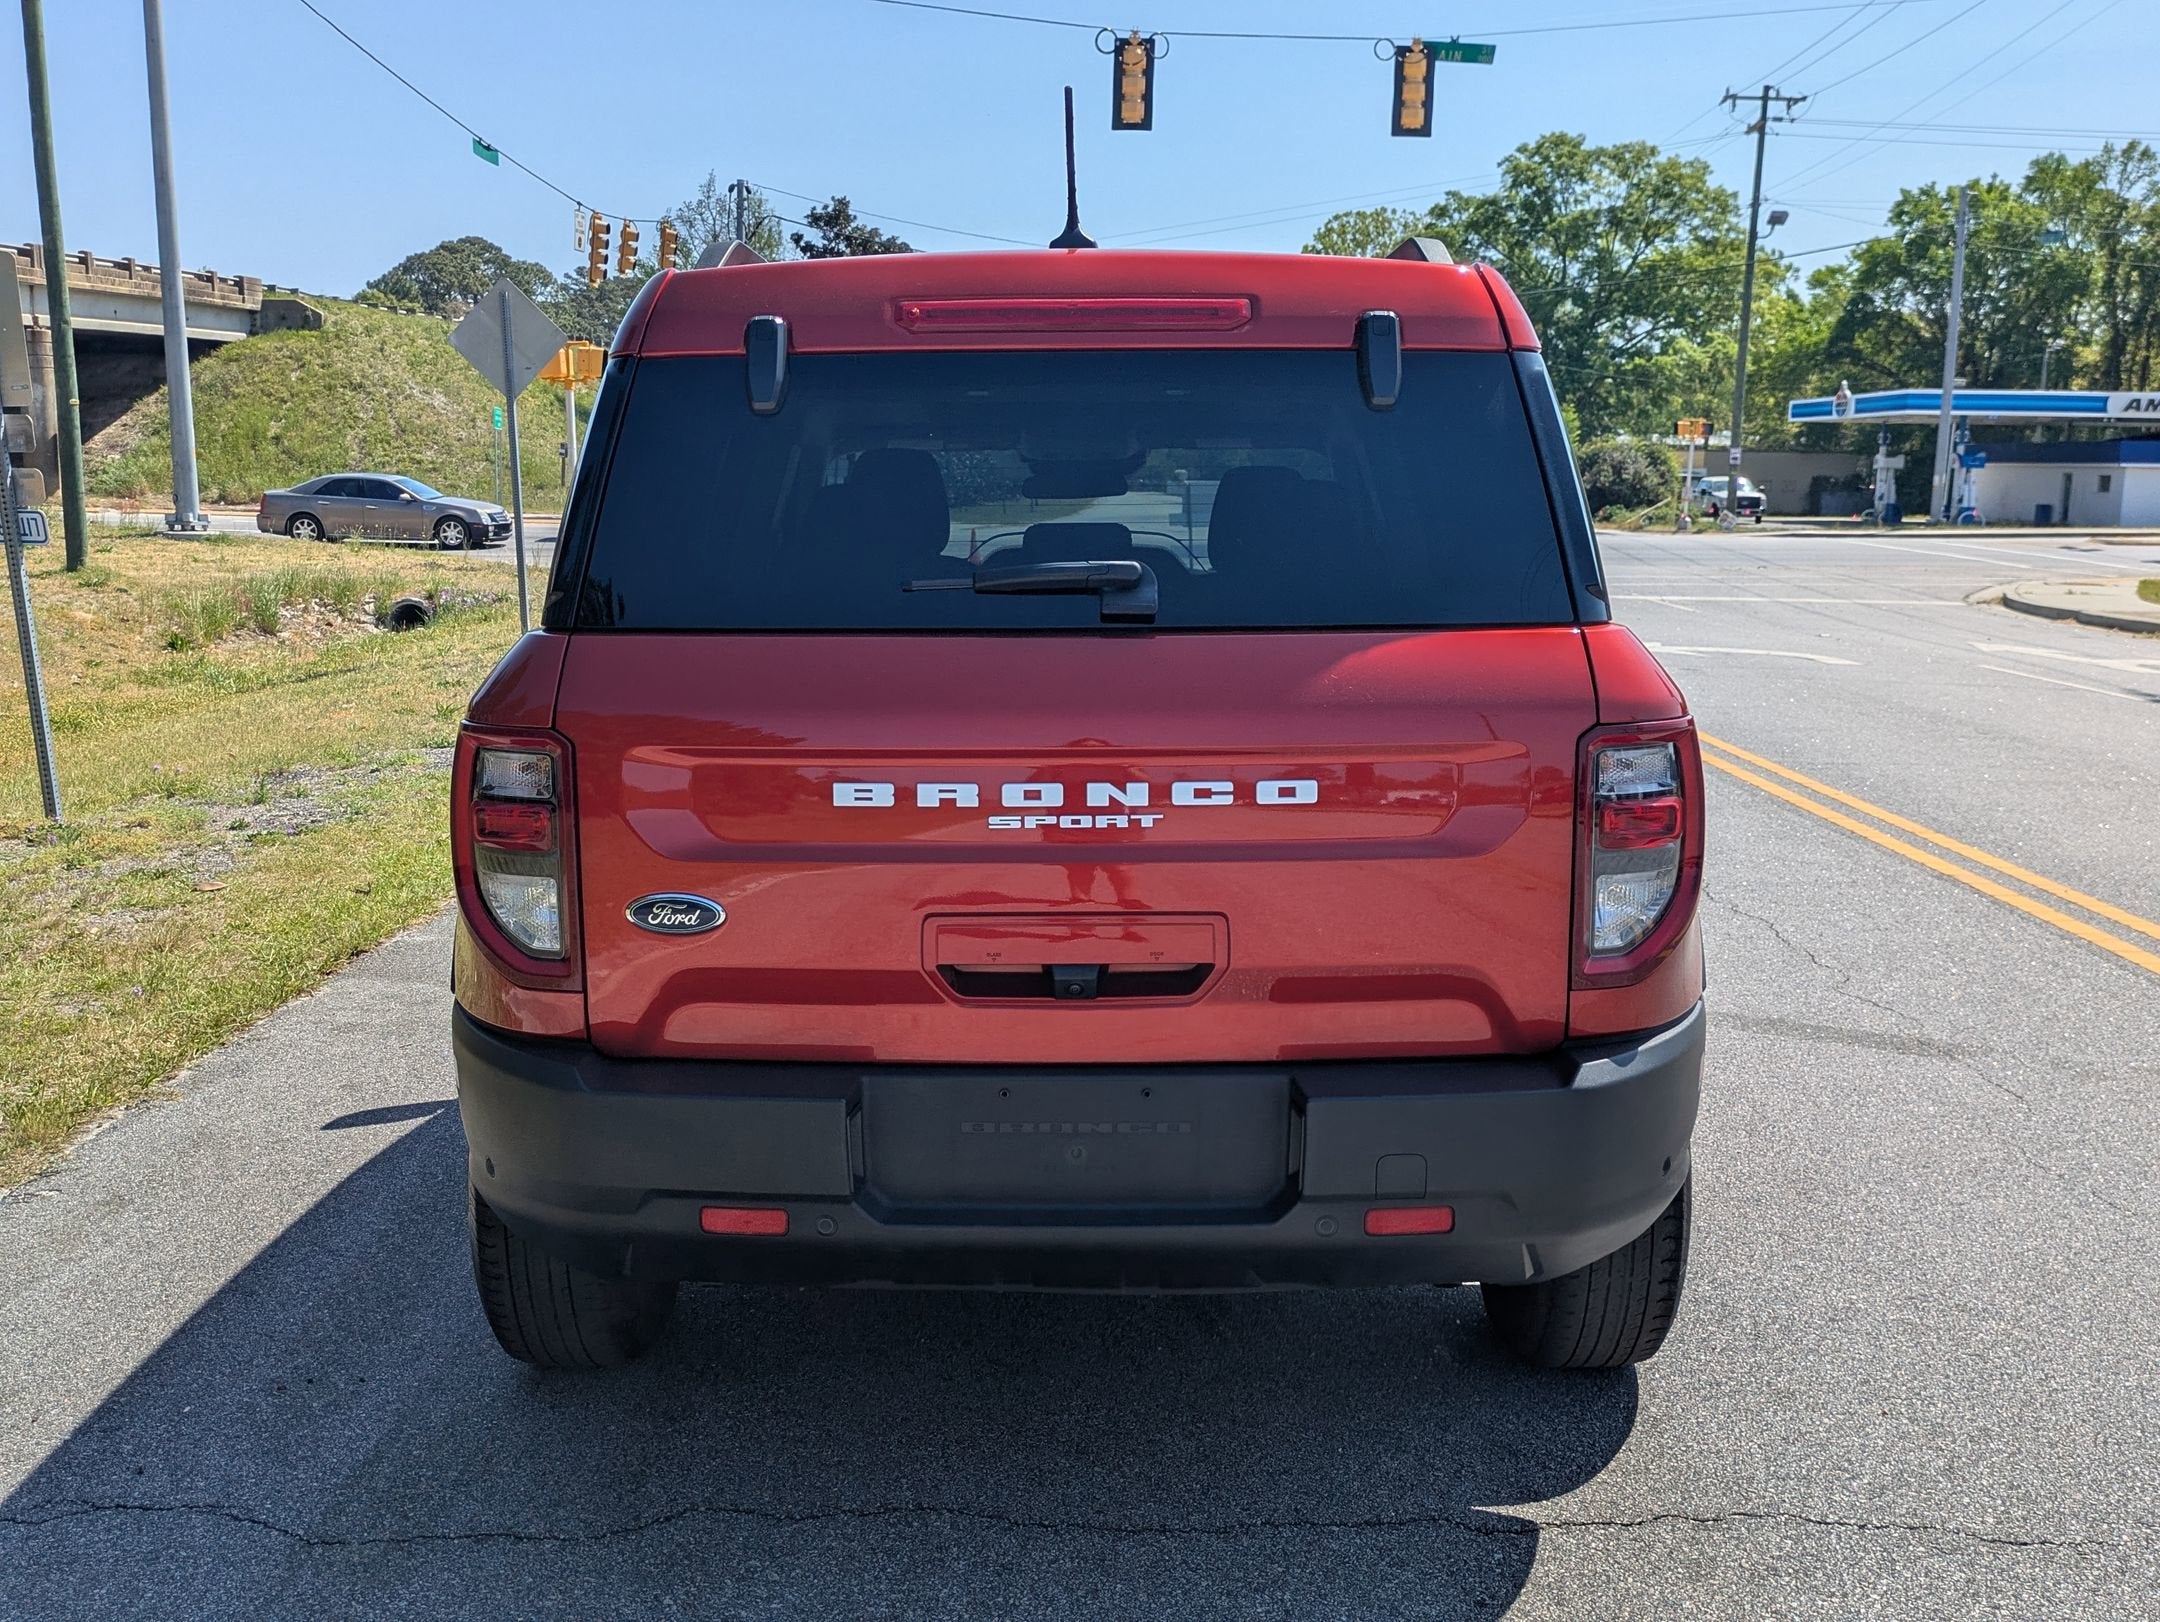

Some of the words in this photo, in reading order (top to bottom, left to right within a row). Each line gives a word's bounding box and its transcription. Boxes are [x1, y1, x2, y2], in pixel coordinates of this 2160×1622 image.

[832, 780, 1319, 808] BRONCO
[987, 814, 1164, 829] SPORT
[648, 902, 701, 925] Ford
[960, 1121, 1192, 1134] BRONCO
